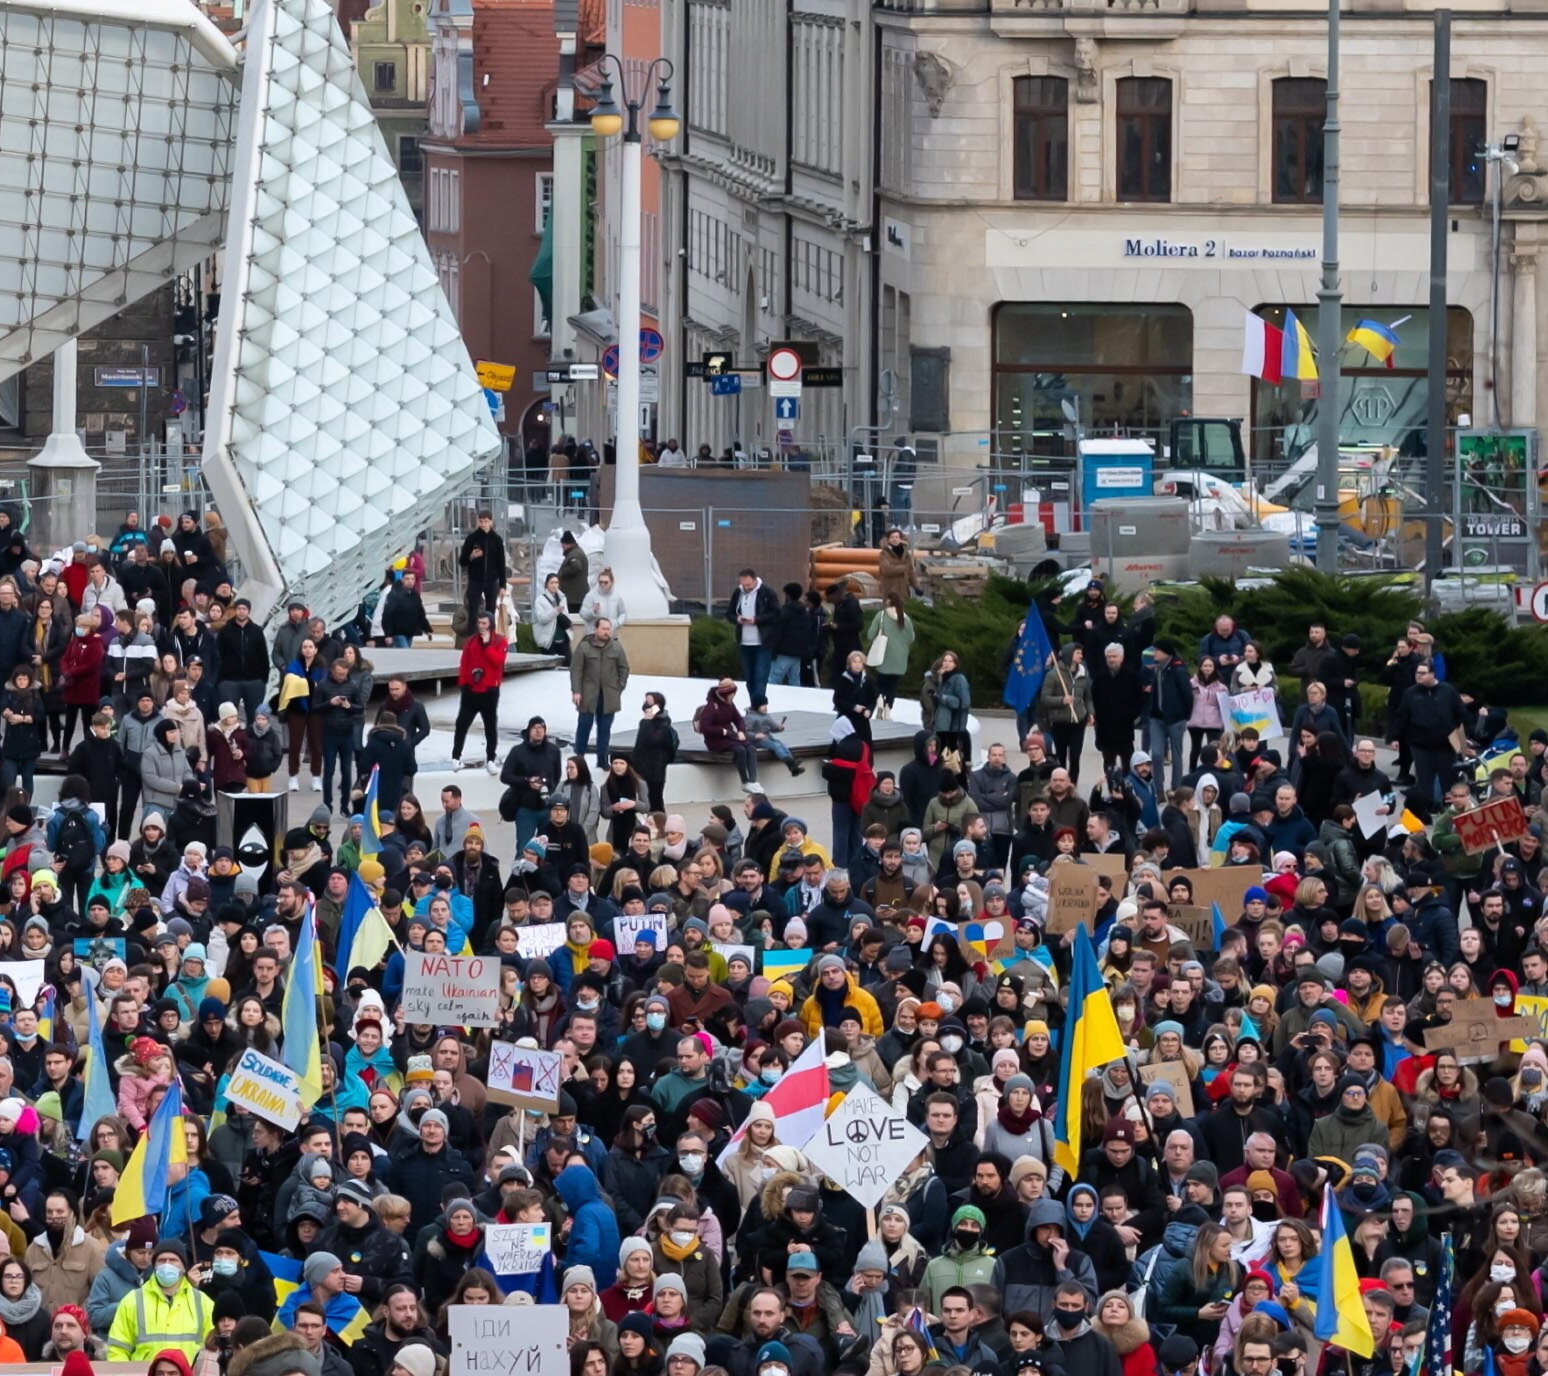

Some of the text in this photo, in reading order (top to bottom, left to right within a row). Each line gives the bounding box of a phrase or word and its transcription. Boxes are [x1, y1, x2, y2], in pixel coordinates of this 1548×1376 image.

[1125, 239, 1217, 257] Moliera 2
[1229, 248, 1315, 261] Bazar Poznański
[1467, 524, 1521, 535] TOWER
[420, 958, 483, 980] NATO
[844, 1098, 879, 1116] MAKE
[827, 1118, 905, 1148] LOVE
[848, 1144, 879, 1165] NOT
[846, 1165, 886, 1188] WAR
